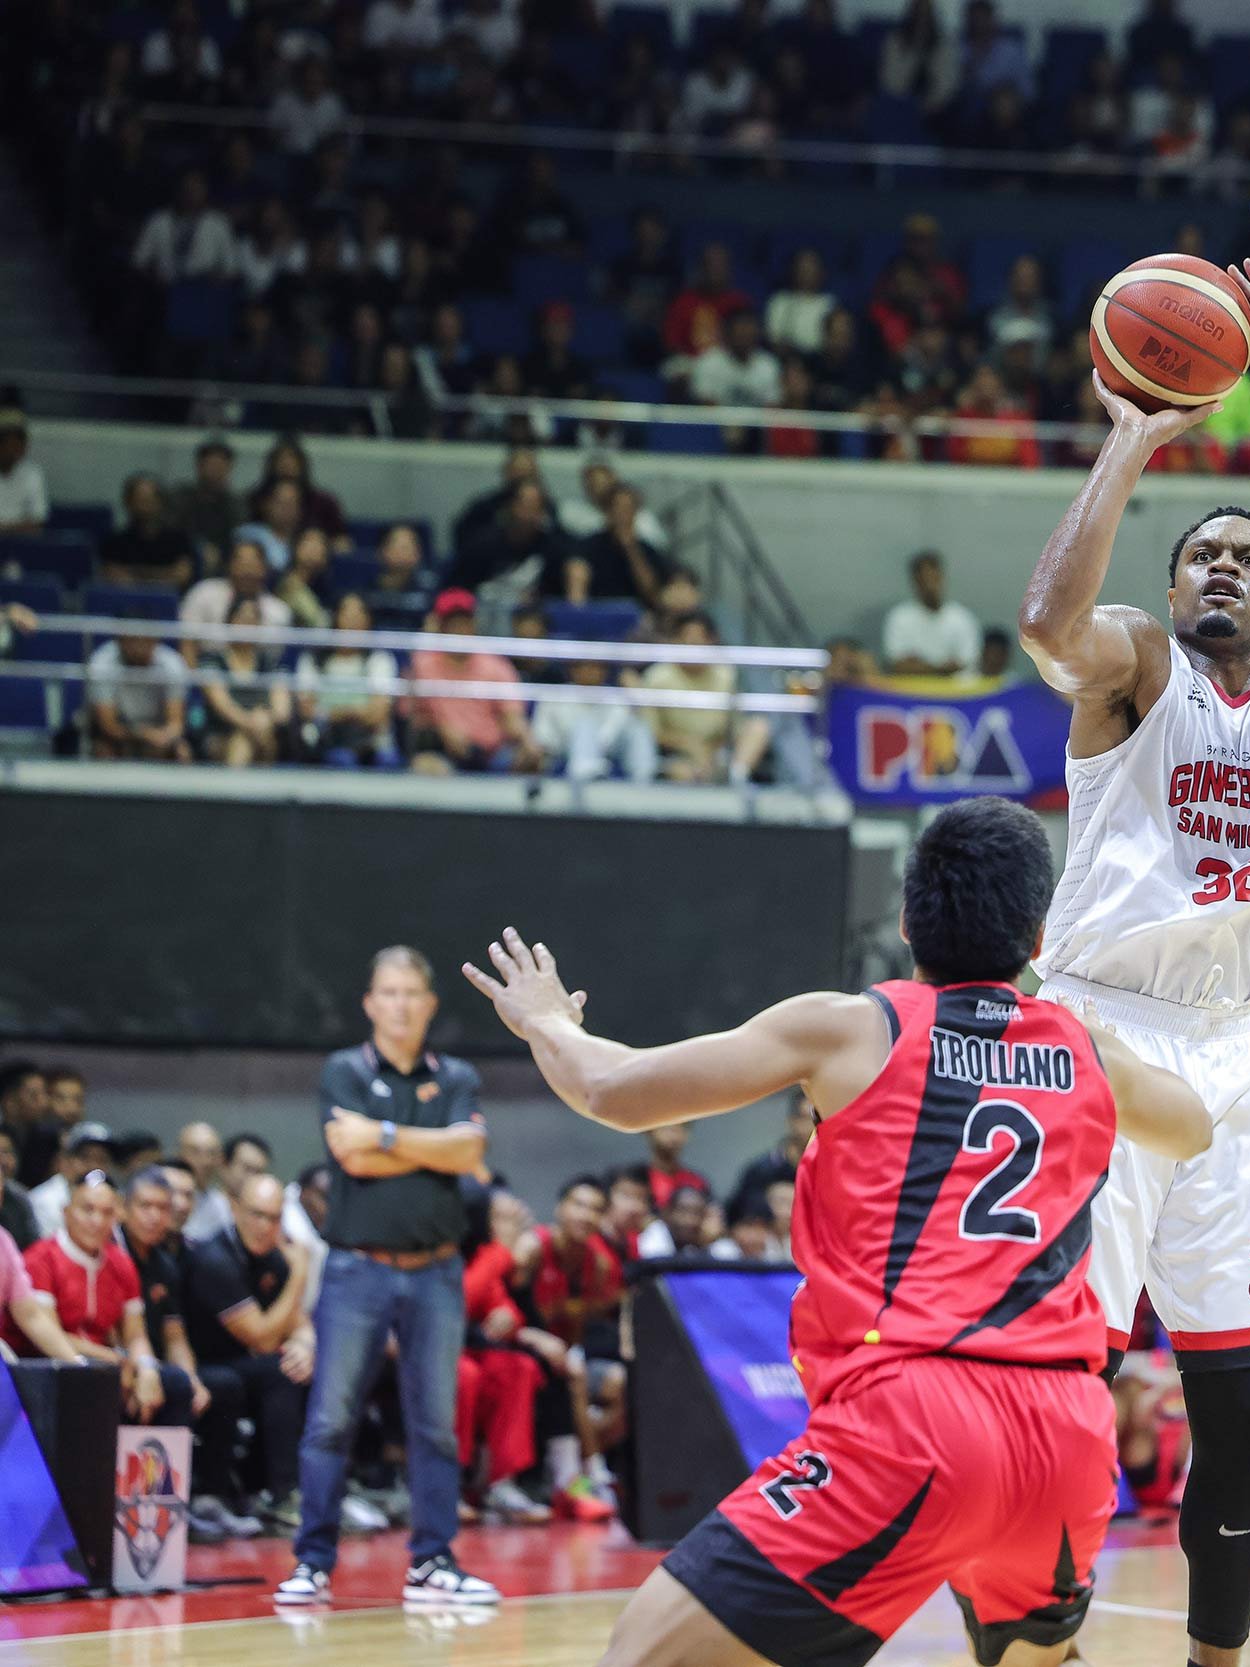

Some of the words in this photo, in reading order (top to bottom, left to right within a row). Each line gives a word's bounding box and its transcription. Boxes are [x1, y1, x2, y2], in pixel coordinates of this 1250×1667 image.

[1159, 296, 1225, 341] molten
[1138, 335, 1192, 384] PBA
[855, 705, 1033, 792] PBA
[1177, 806, 1222, 843] SAN
[930, 1026, 1076, 1094] TROLLANO
[958, 1098, 1045, 1244] 2
[758, 1449, 833, 1521] 2
